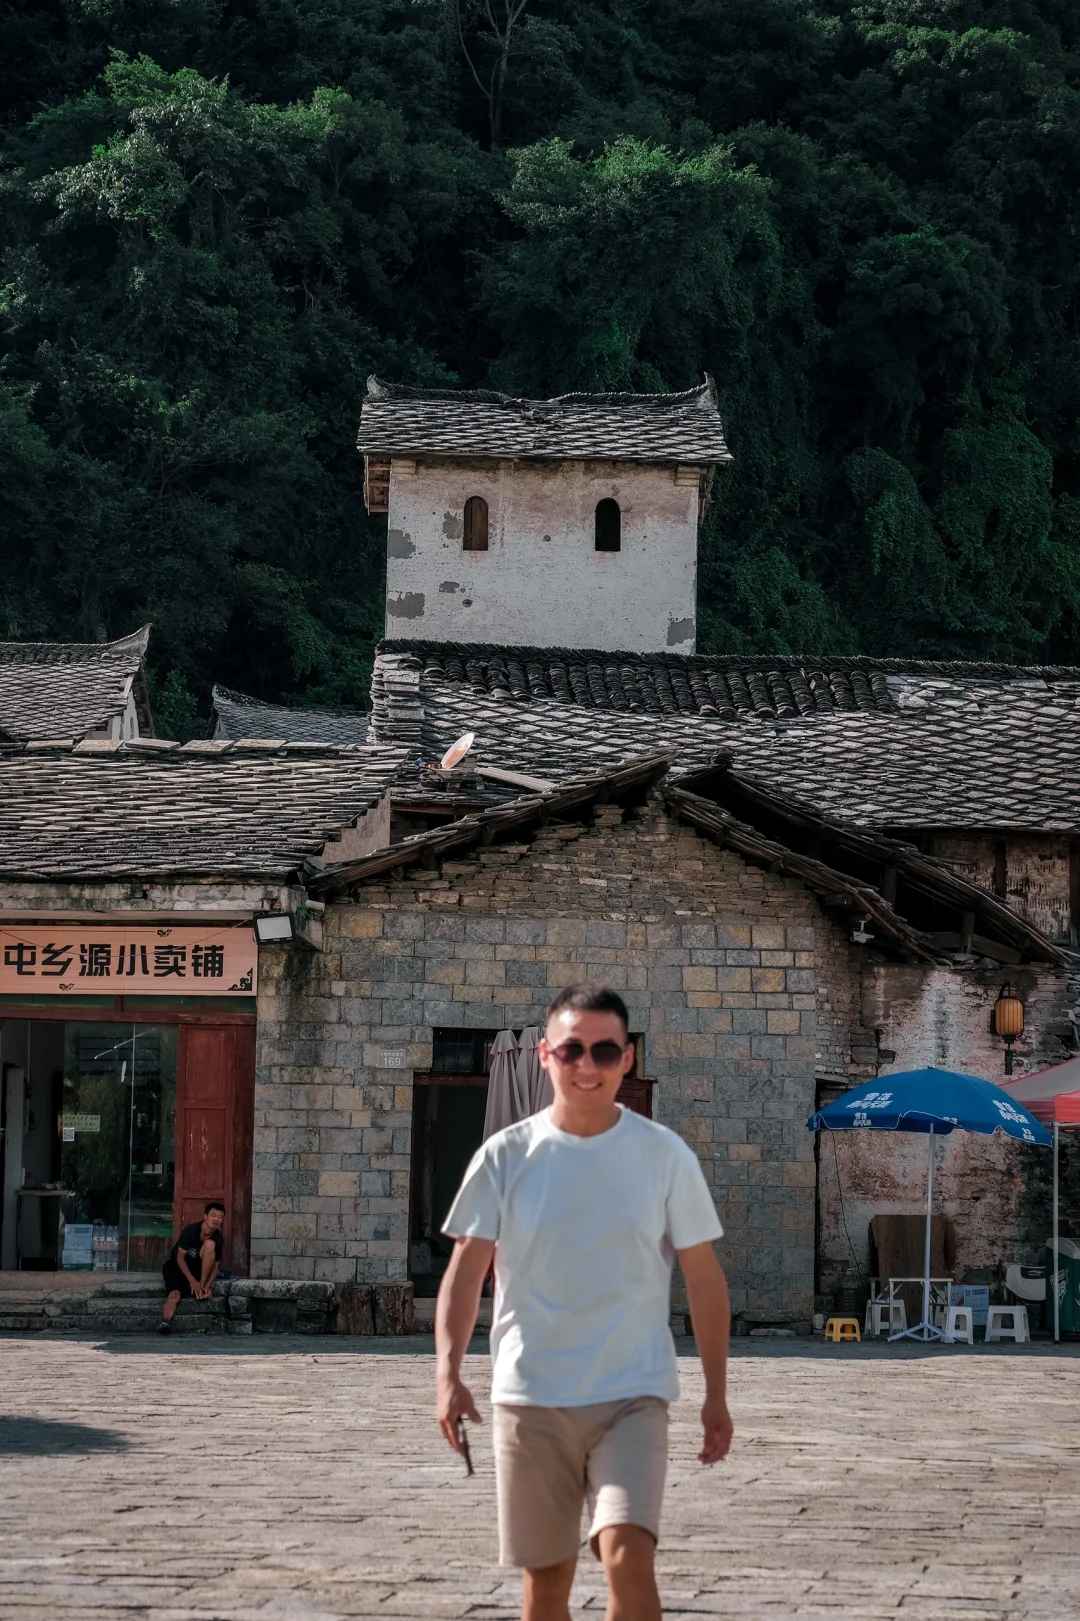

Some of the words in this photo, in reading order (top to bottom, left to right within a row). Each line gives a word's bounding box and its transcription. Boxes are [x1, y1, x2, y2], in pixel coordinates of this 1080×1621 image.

[4, 943, 225, 978] 屯乡源小卖铺
[383, 1056, 401, 1067] 169
